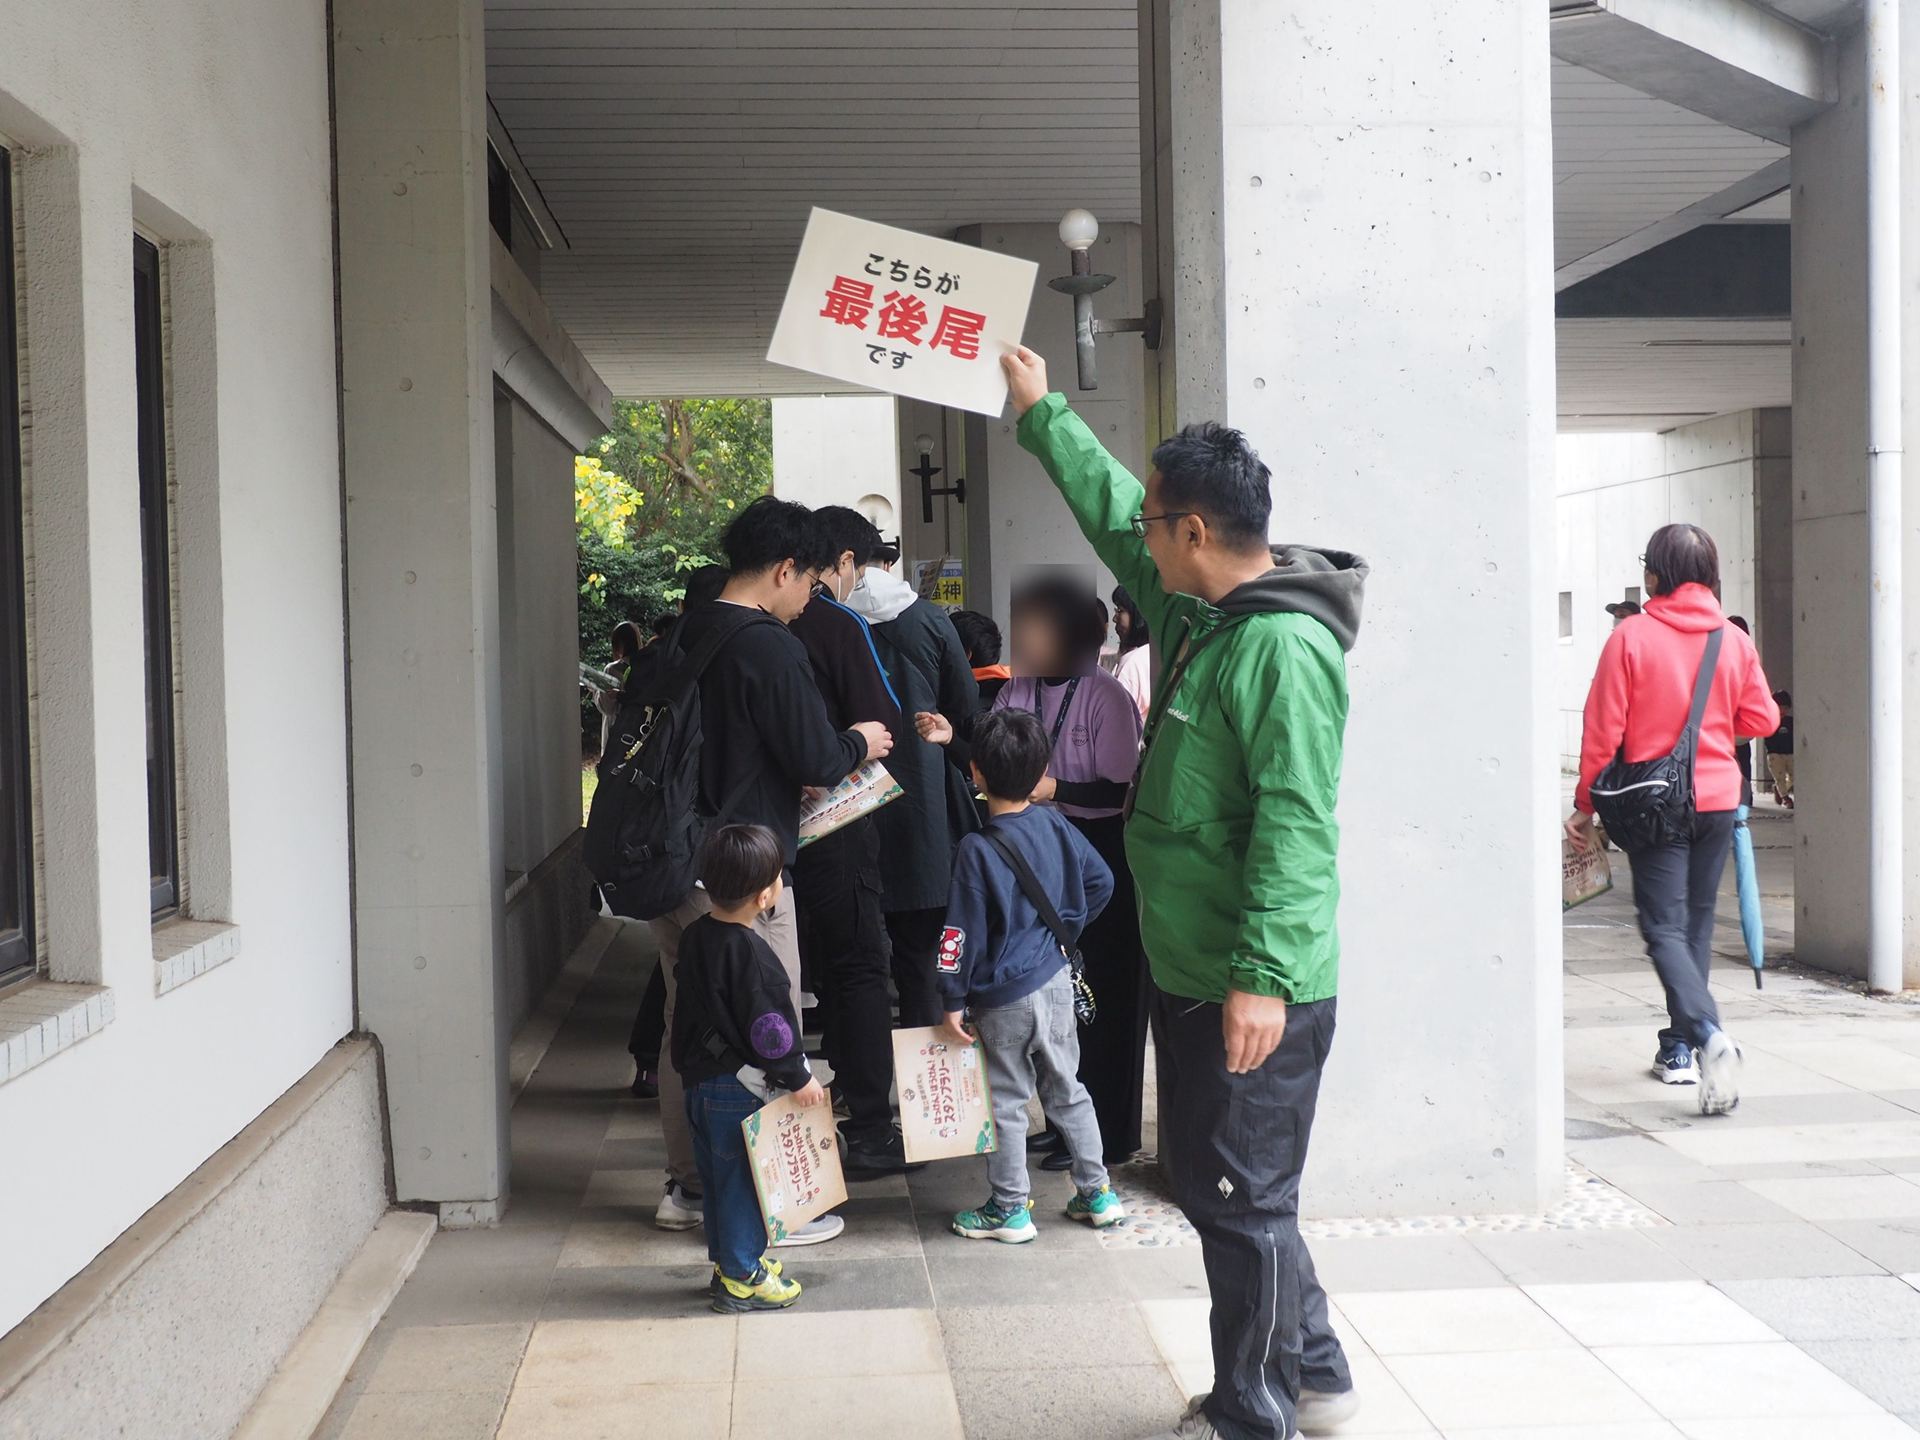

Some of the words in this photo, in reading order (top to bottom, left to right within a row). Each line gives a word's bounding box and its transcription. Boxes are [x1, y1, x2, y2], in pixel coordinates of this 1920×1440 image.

[864, 253, 961, 295] こちらが
[820, 275, 987, 361] 最後尾
[866, 343, 912, 370] です
[939, 1058, 956, 1123] スタンプラリー
[781, 1128, 802, 1192] スタンプラリー
